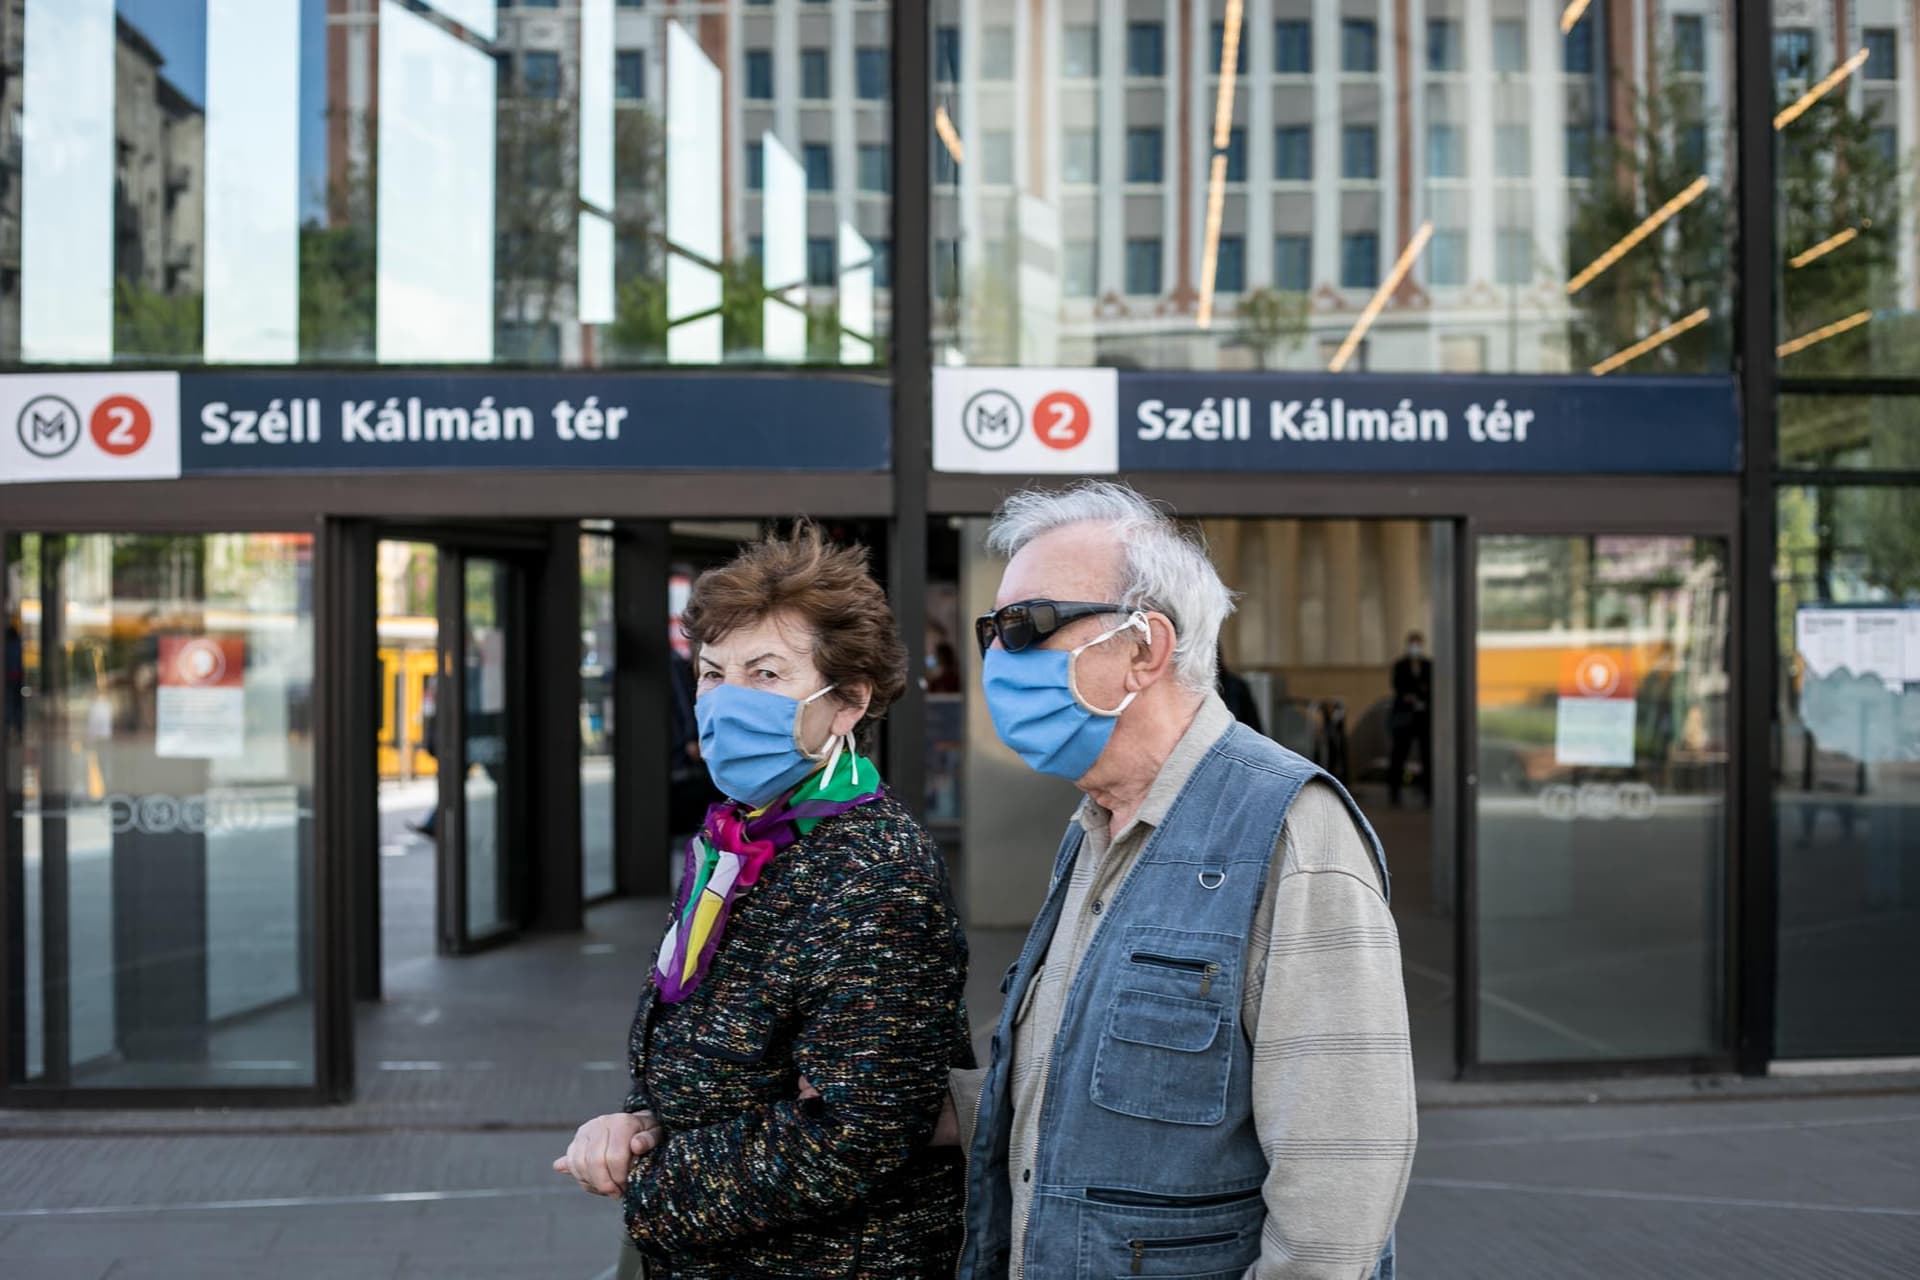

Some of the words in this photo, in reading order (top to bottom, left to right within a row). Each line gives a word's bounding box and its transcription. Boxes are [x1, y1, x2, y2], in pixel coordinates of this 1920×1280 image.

[106, 406, 135, 445] 2
[201, 398, 321, 444] Széll
[341, 396, 534, 442] Kálmán
[551, 396, 628, 441] tér
[1047, 402, 1076, 440] 2
[1137, 397, 1251, 441] Széll
[1269, 398, 1448, 442] Kálmán
[1464, 399, 1535, 442] tér
